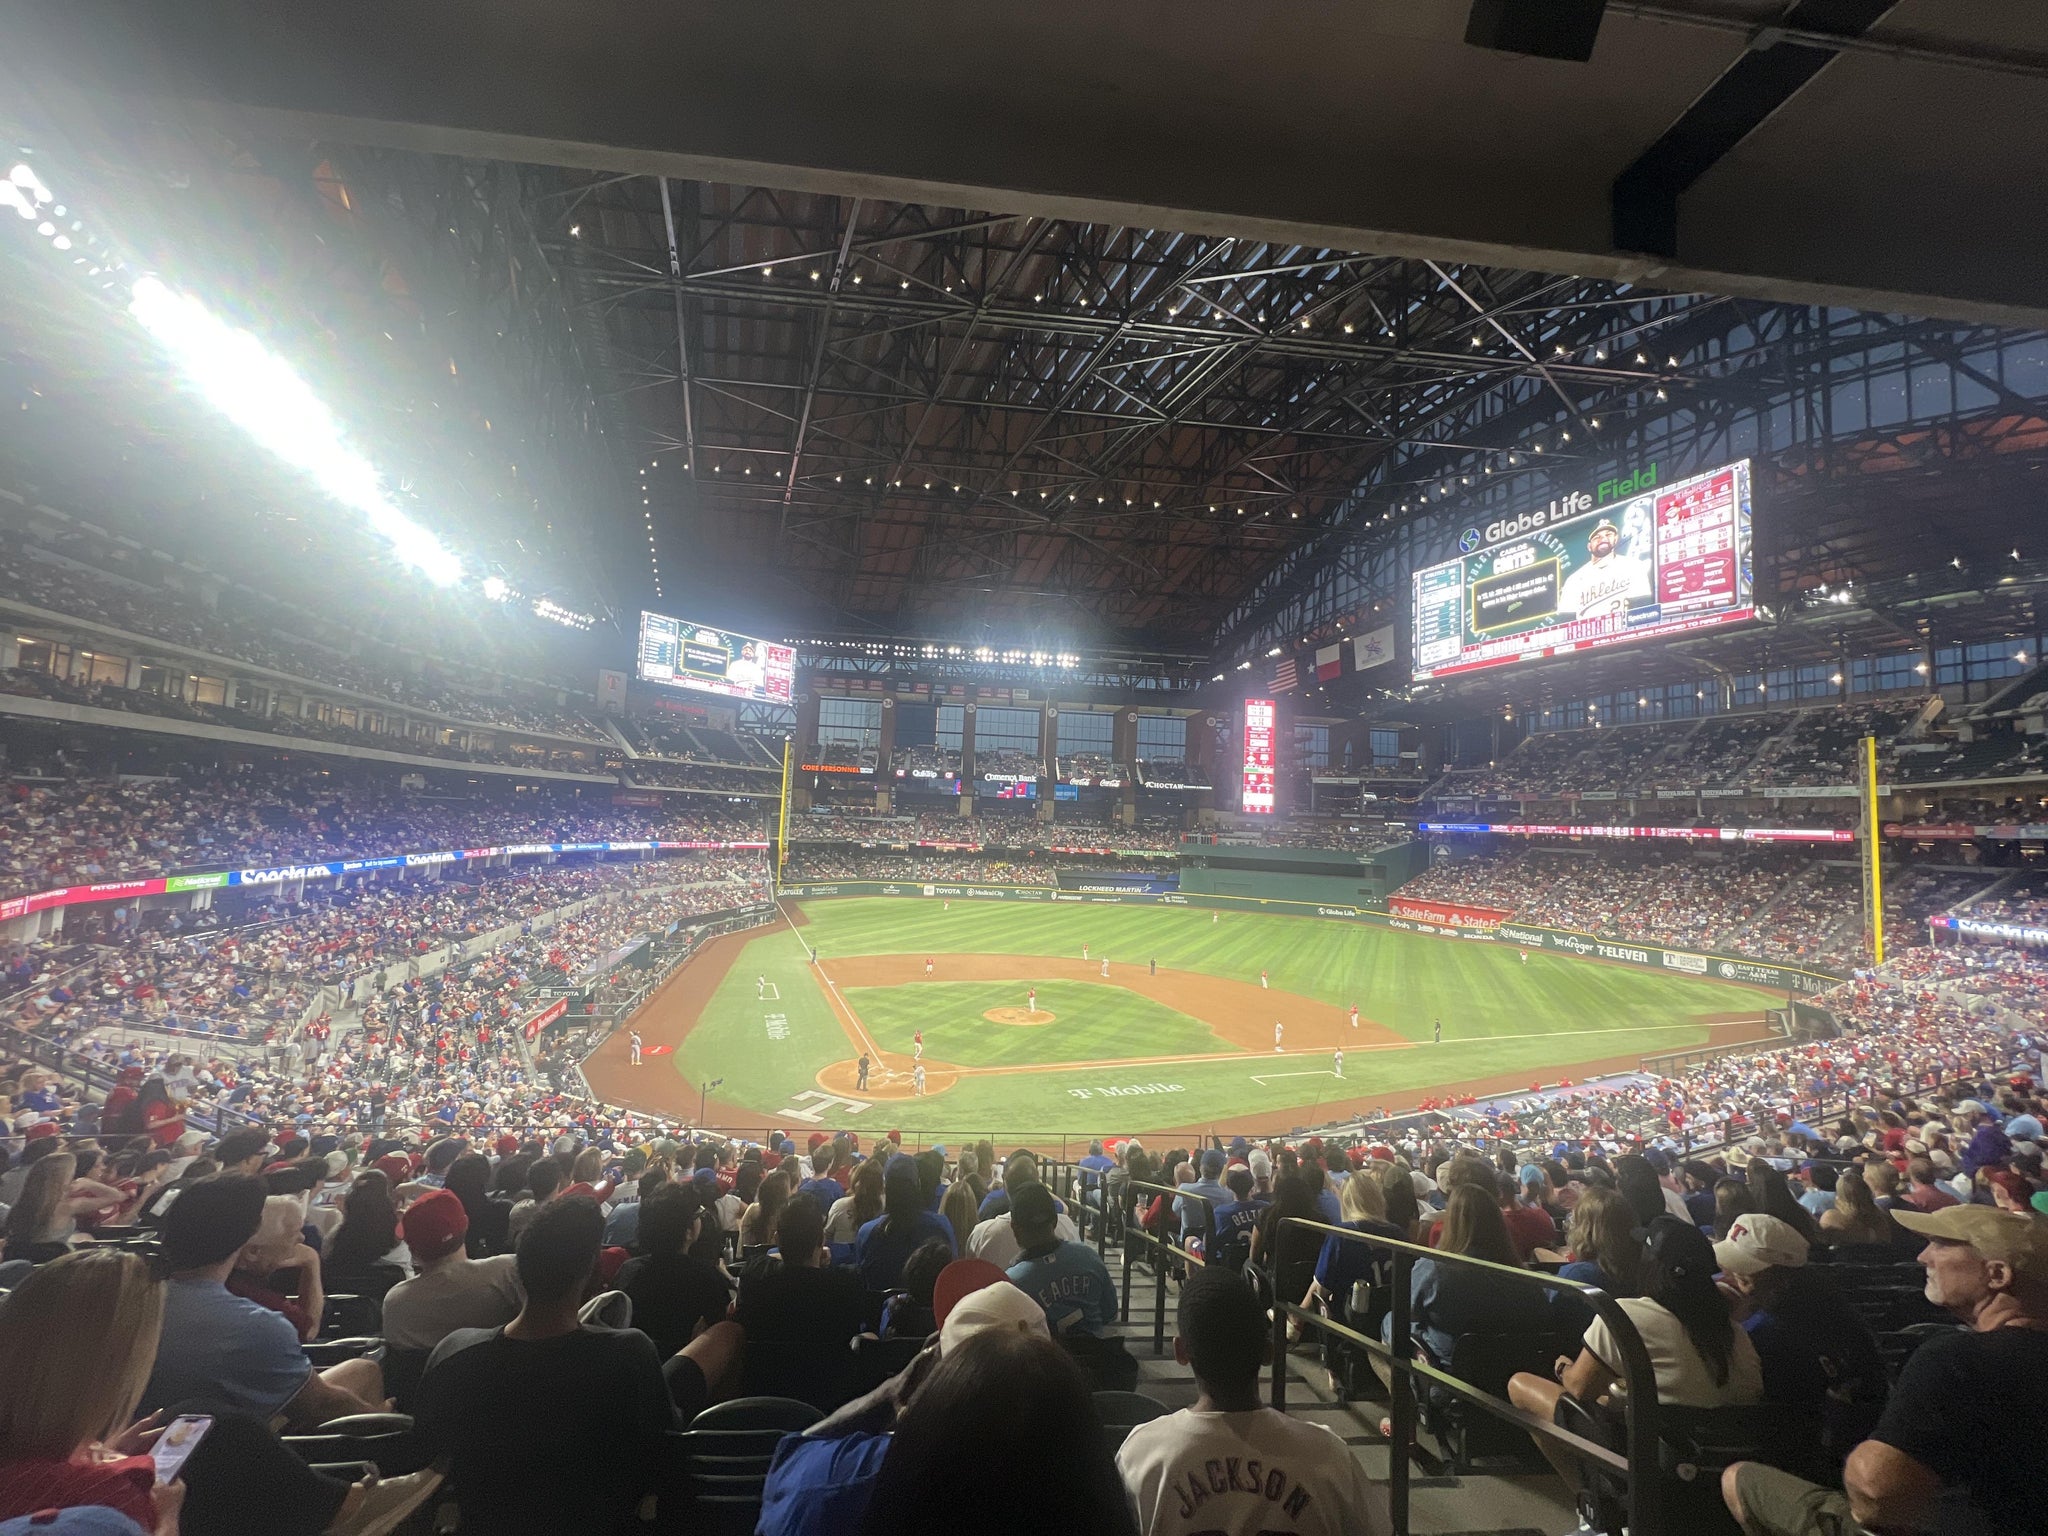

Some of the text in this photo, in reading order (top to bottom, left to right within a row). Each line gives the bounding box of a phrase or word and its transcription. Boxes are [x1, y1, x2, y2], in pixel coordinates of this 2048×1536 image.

[1485, 462, 1657, 543] Globe Life Field
[1628, 610, 1660, 622] Spectrum
[820, 766, 860, 774] PERSONNEL
[91, 884, 120, 892] PITCH
[184, 876, 222, 886] National
[777, 887, 804, 896] SEATGEEK
[1402, 906, 1446, 922] State Farm
[1464, 916, 1488, 928] State
[1509, 930, 1544, 942] National
[1564, 936, 1594, 954] Kroger
[1748, 971, 1767, 979] A&M
[1756, 967, 1779, 976] TEXAS
[1792, 974, 1832, 994] T Mobil
[1068, 1083, 1186, 1099] T Mobile
[1232, 1208, 1263, 1227] BELT
[1730, 1223, 1748, 1242] T
[1038, 1276, 1090, 1308] EAGER
[1174, 1456, 1313, 1520] JACKSON
